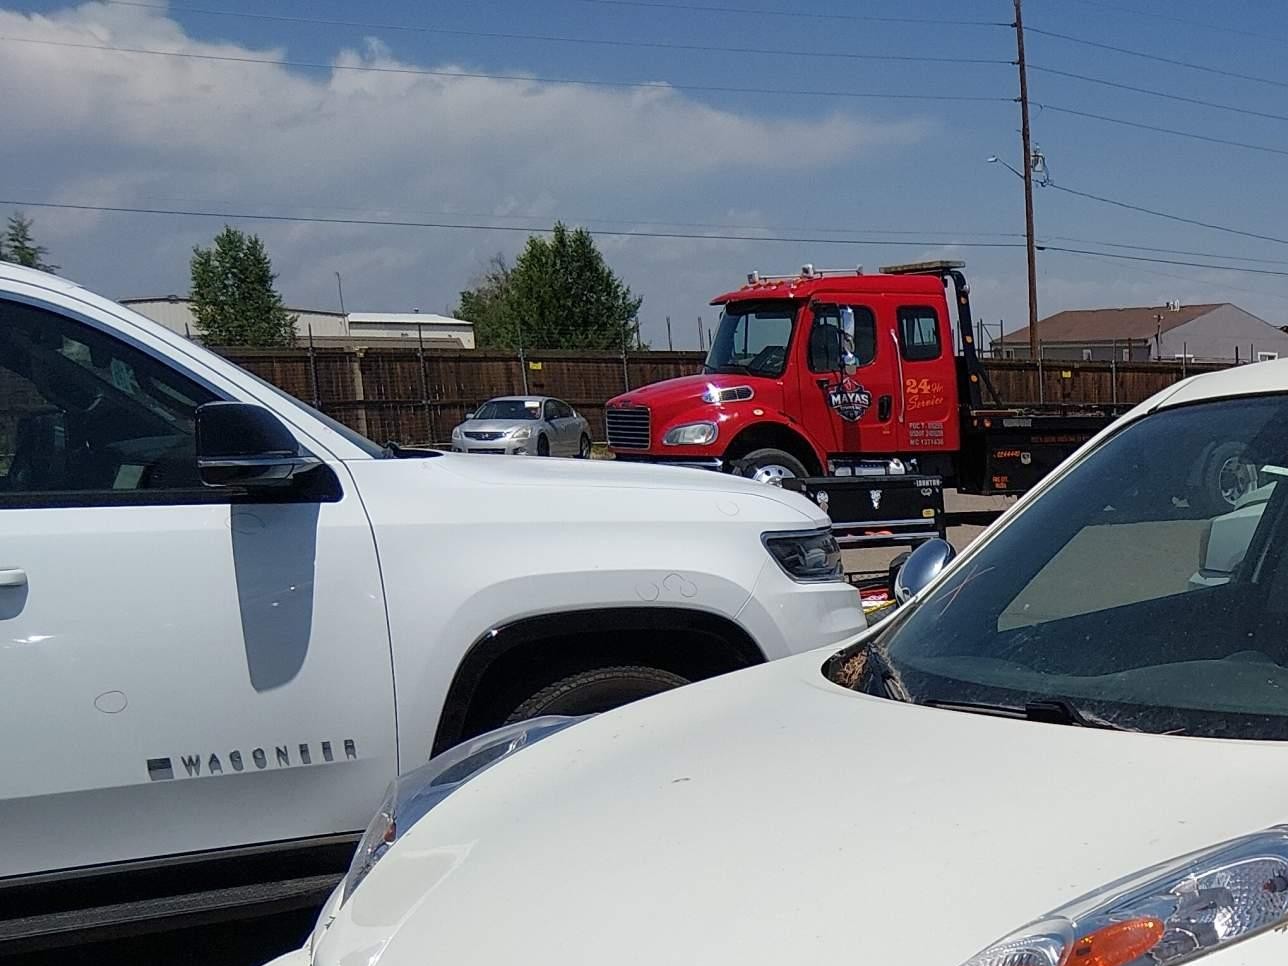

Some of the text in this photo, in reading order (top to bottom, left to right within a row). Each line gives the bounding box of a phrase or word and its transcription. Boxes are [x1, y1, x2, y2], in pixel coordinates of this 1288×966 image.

[906, 378, 930, 394] 24
[830, 392, 869, 406] MAYAS
[907, 395, 943, 411] Service
[180, 738, 358, 777] WAGONEER
